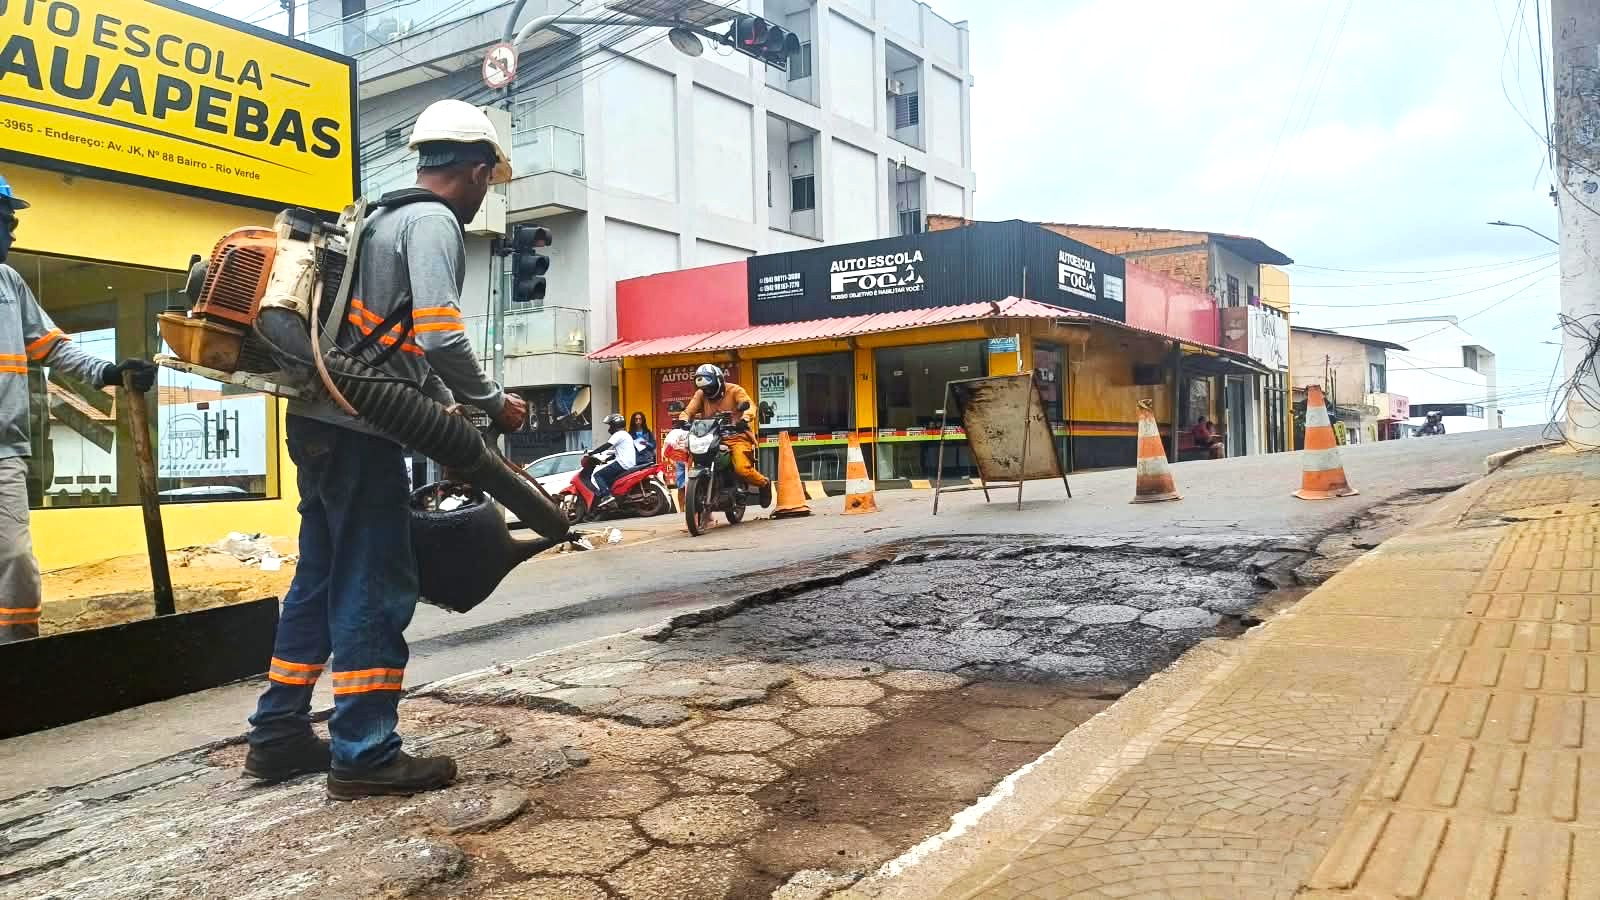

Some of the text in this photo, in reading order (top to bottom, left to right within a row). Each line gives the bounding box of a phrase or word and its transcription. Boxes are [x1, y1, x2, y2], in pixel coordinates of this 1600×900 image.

[0, 0, 264, 91] TO ESCOLA
[0, 34, 341, 159] AUAPEBAS
[0, 118, 34, 133] -3965
[45, 127, 105, 148] Endereço:
[107, 141, 124, 153] Av.
[127, 145, 144, 158] JK,
[162, 152, 174, 162] 88
[177, 155, 207, 169] Bairro
[216, 163, 232, 174] Rio
[234, 167, 260, 180] Verde
[662, 368, 730, 383] AUTOEA
[760, 375, 785, 388] CNH
